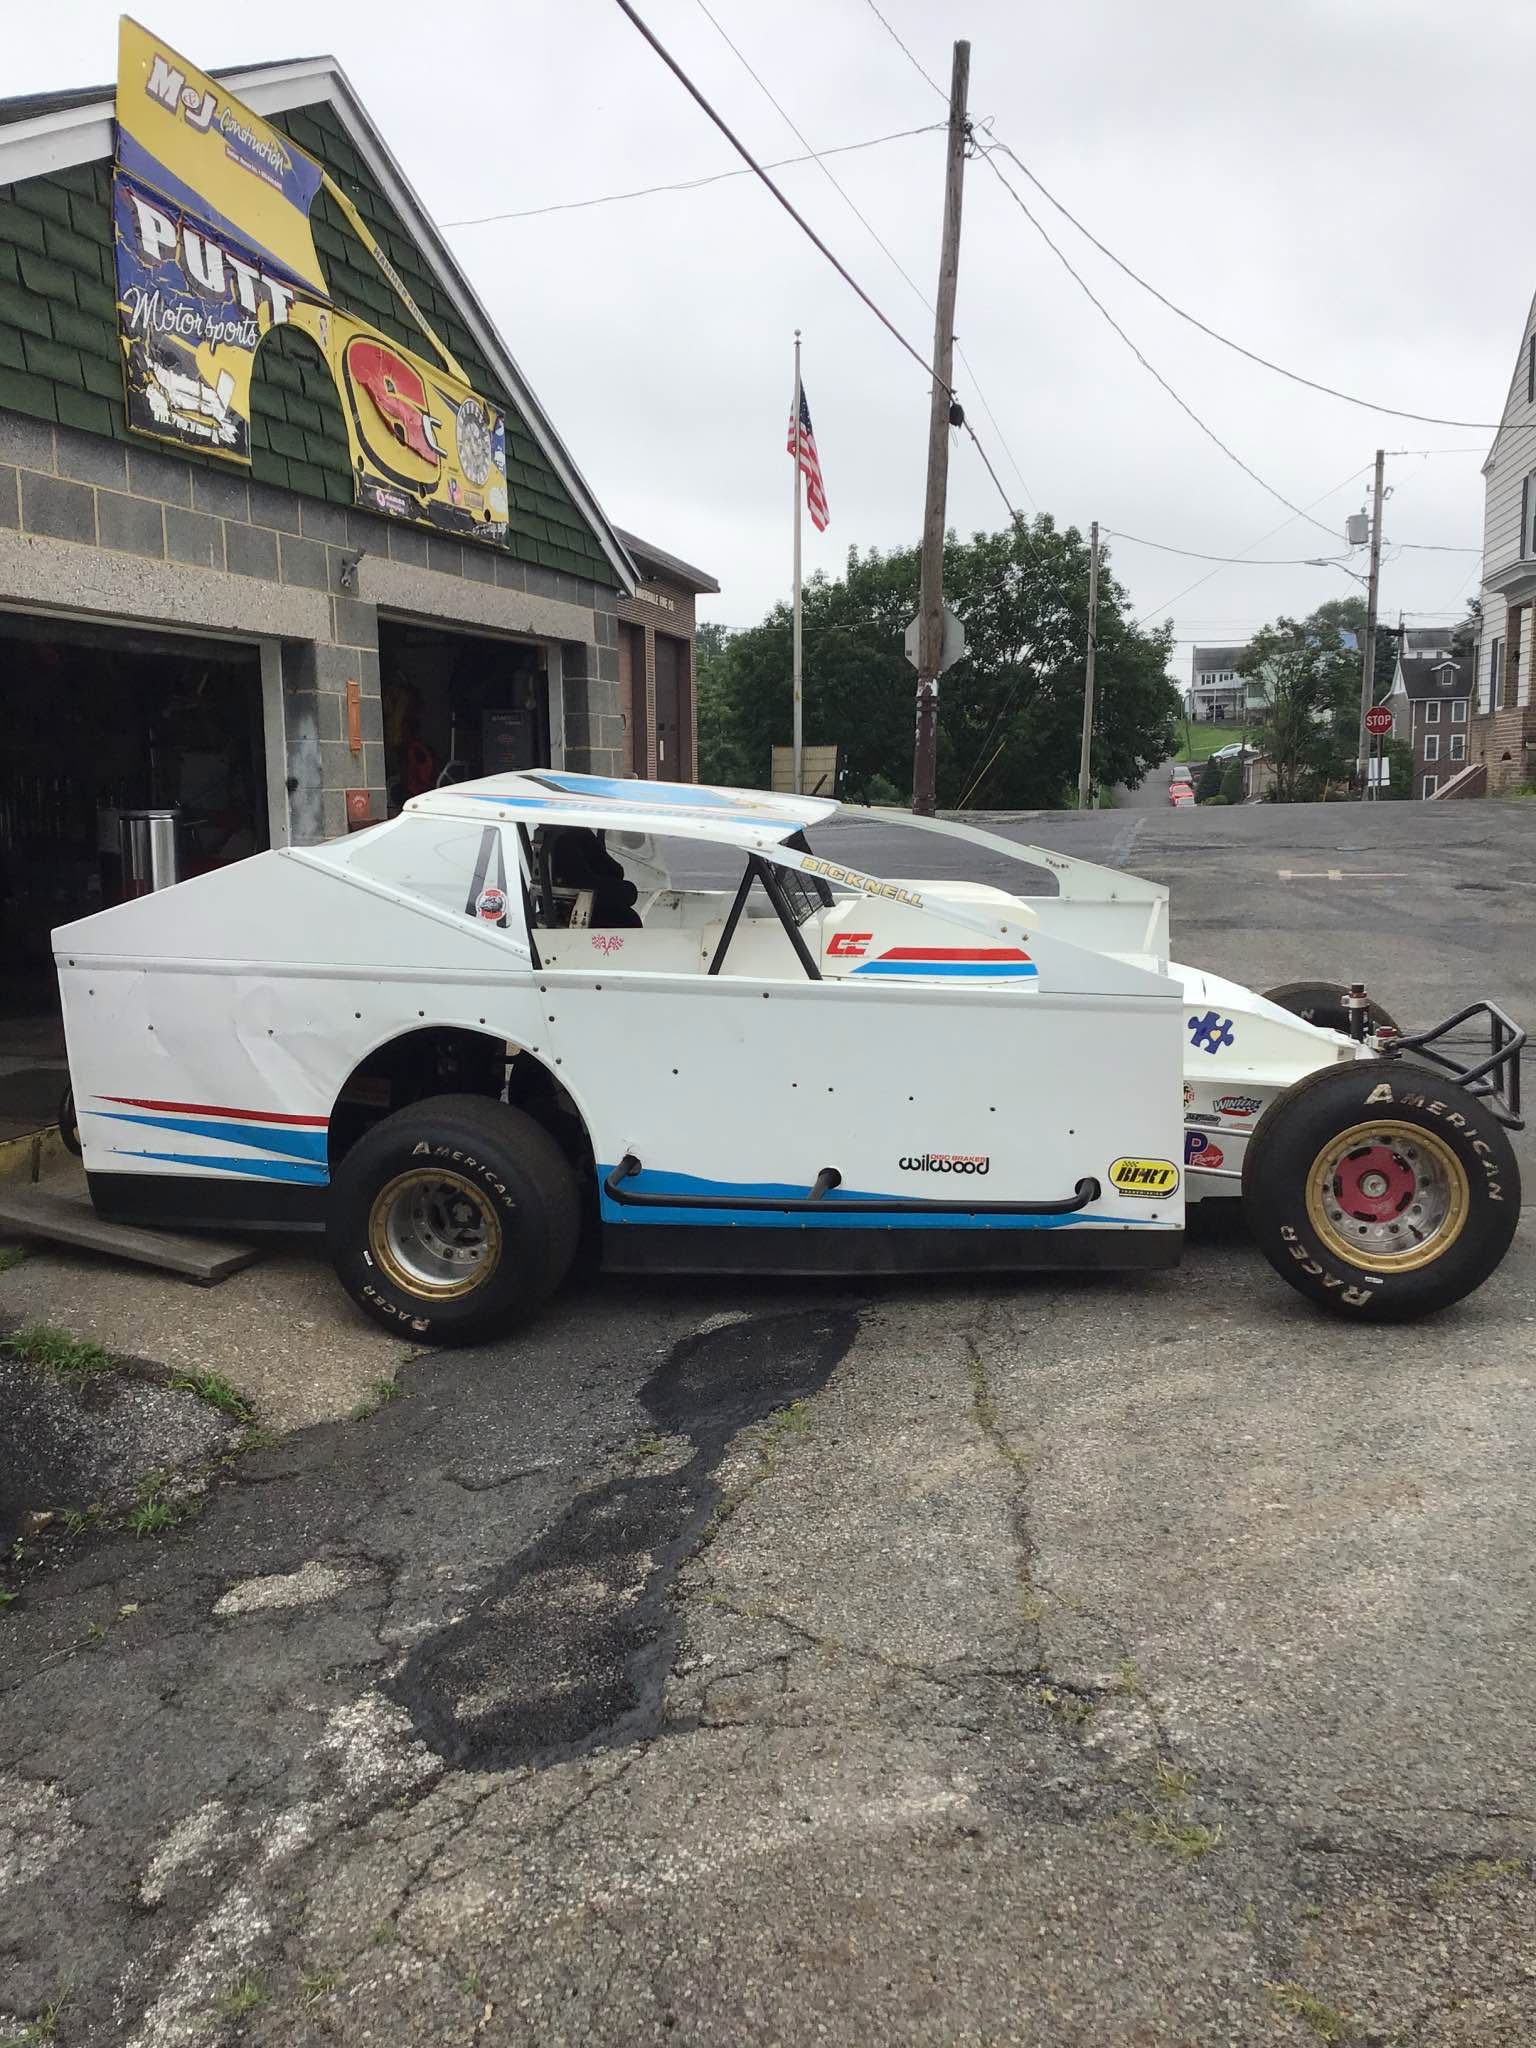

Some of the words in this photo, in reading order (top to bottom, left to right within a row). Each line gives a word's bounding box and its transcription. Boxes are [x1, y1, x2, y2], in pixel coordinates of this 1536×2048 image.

[146, 54, 217, 133] M&J
[219, 107, 284, 176] Construction
[131, 195, 294, 324] PUTT
[1366, 714, 1391, 726] STOP
[800, 857, 923, 908] BICKNELL
[899, 1153, 990, 1175] wilwood
[1363, 1082, 1504, 1201] AMERICAN
[412, 1141, 516, 1208] AMERICAN
[1115, 1167, 1175, 1185] BERT
[1280, 1225, 1374, 1307] RACER
[362, 1285, 430, 1331] RACER
